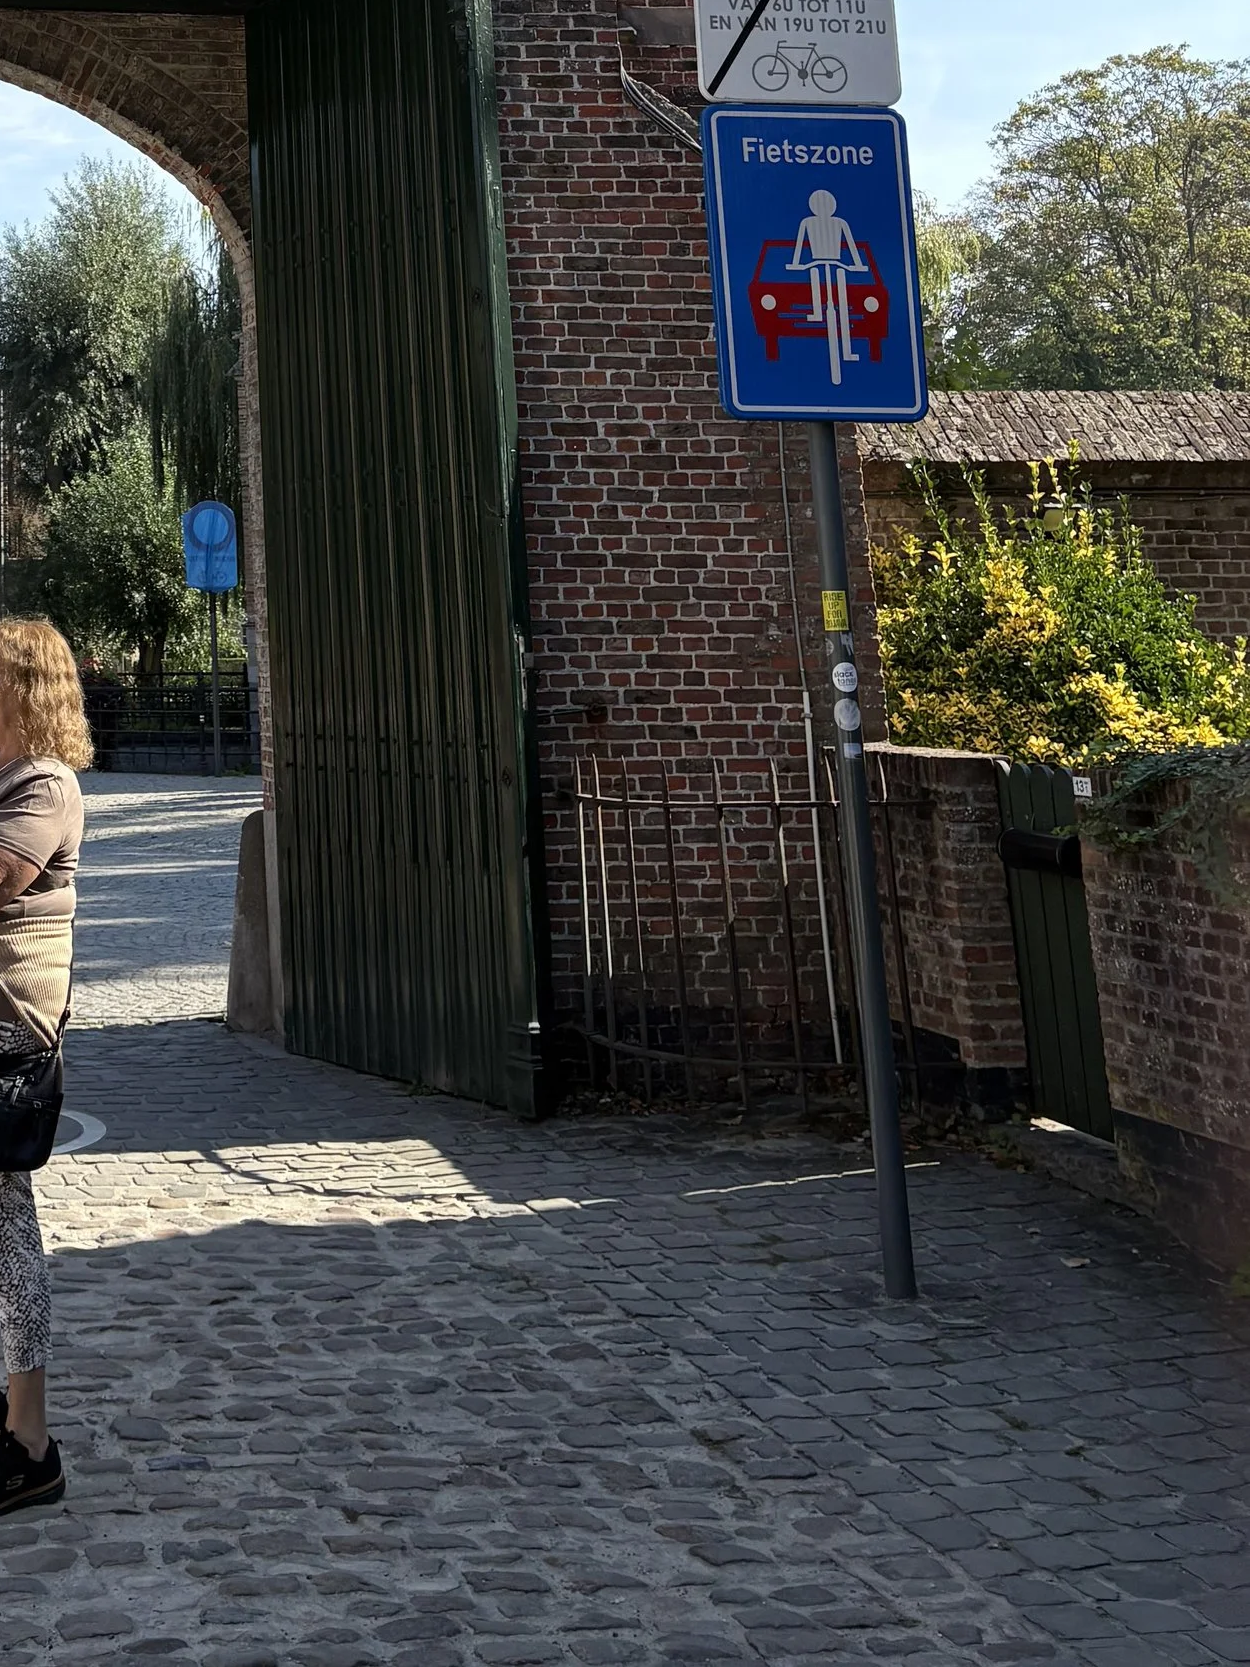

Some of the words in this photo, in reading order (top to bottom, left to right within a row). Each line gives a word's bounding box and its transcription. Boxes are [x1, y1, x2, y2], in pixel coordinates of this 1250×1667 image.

[799, 0, 829, 13] TOT
[836, 0, 866, 14] 11U
[709, 15, 731, 30] EN
[783, 17, 814, 33] 19U
[819, 19, 850, 34] TOT
[855, 20, 886, 35] 21U
[741, 137, 873, 166] Fietszone
